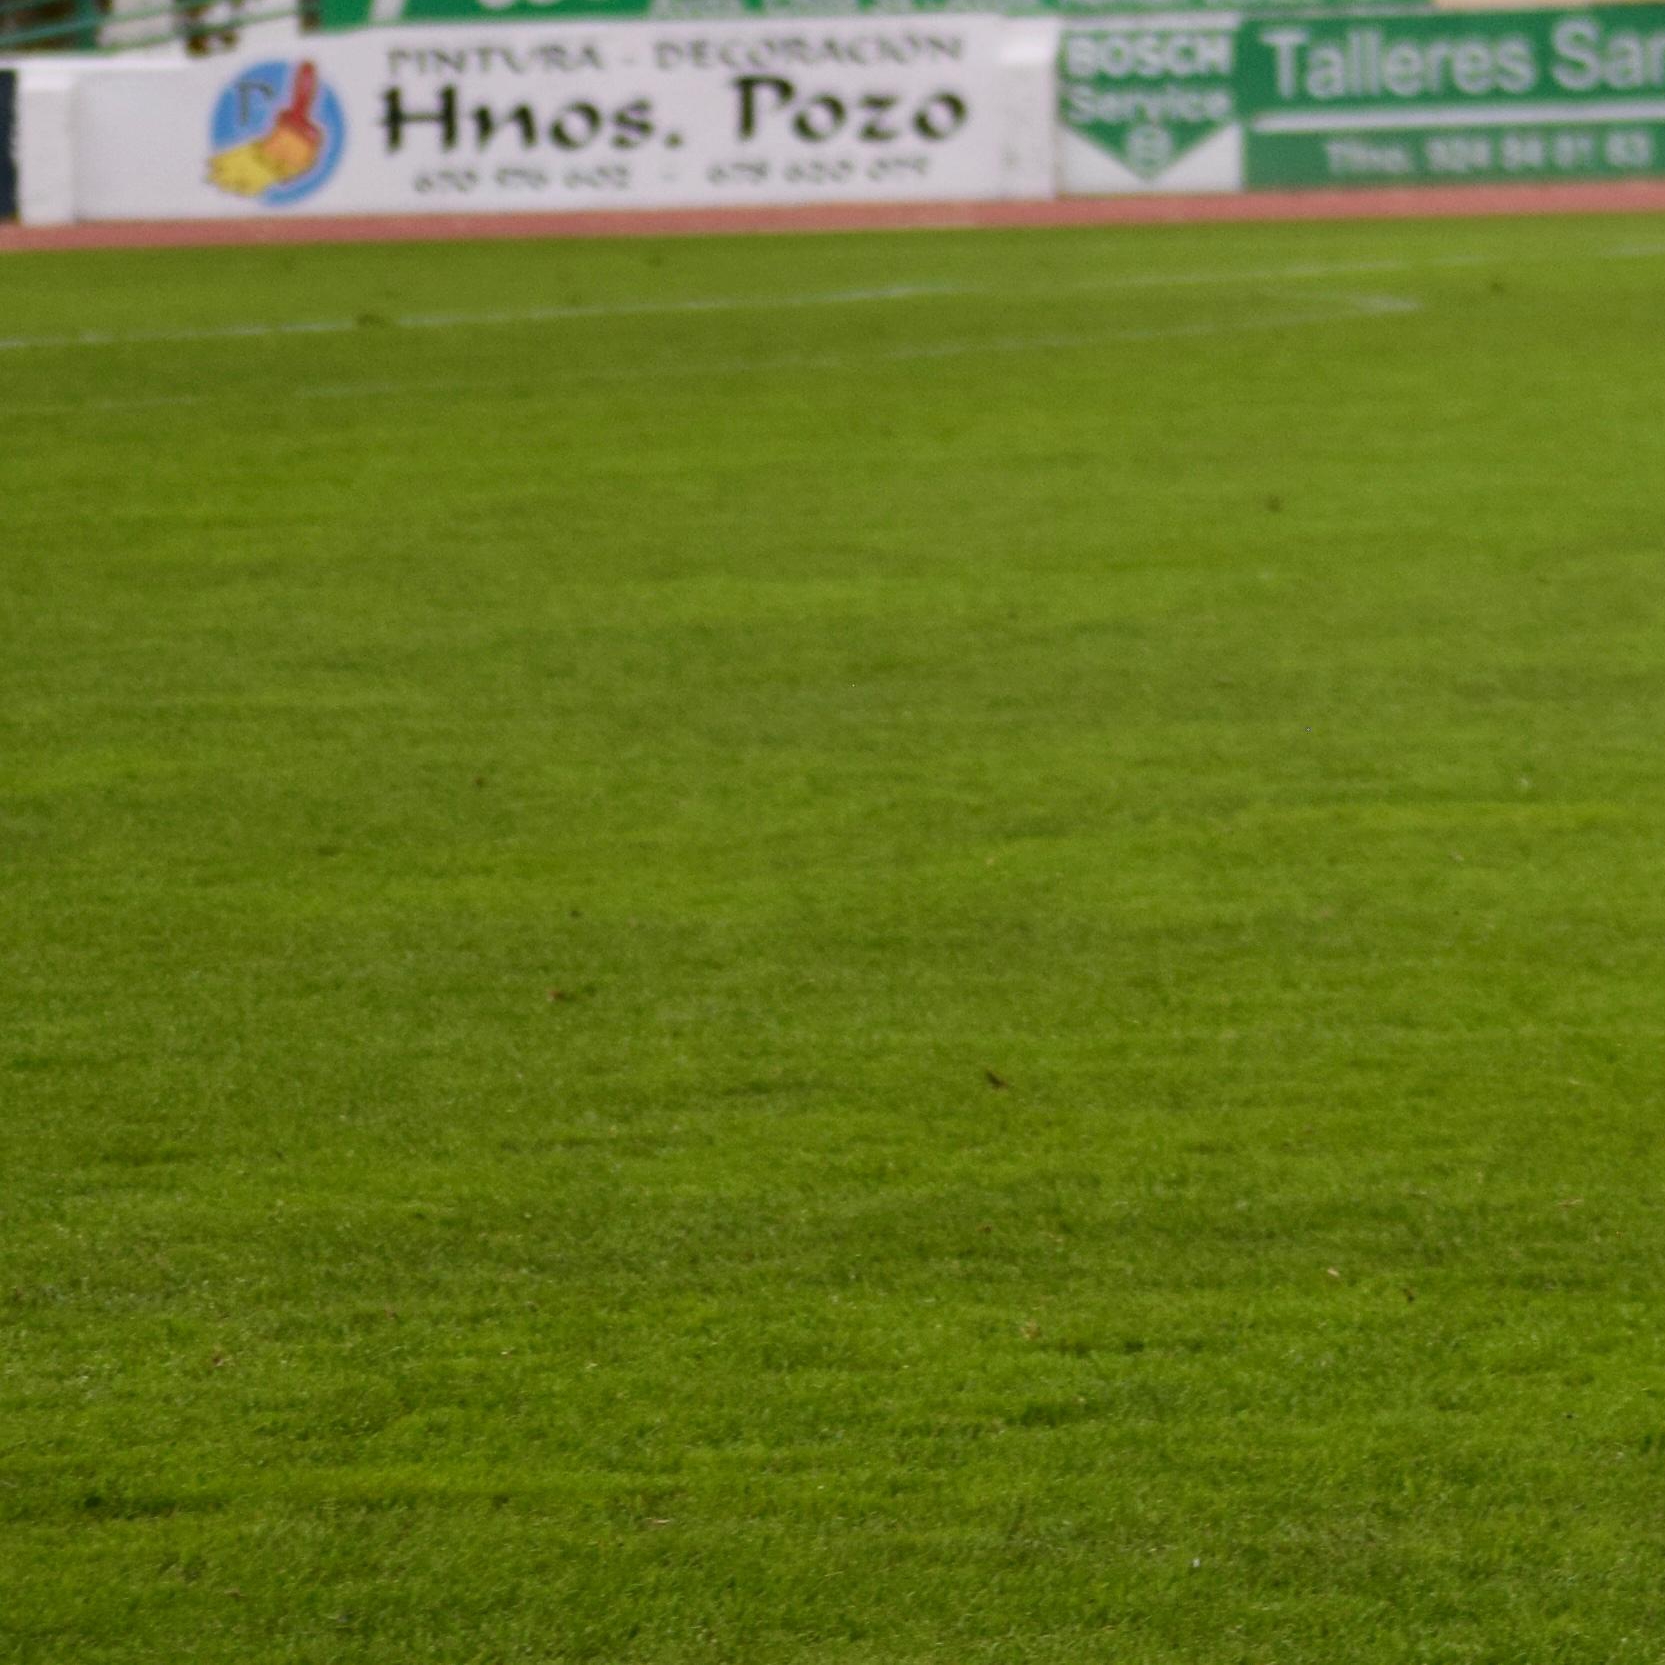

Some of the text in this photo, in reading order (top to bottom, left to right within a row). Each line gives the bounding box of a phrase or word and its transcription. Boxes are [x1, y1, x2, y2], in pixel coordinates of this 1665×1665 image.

[385, 38, 605, 77] PINTURA
[653, 33, 968, 73] DECORACIÓN
[1066, 35, 1234, 79] BOSCH
[1262, 27, 1540, 101] Talleres
[378, 73, 970, 157] Hnos. Pozo
